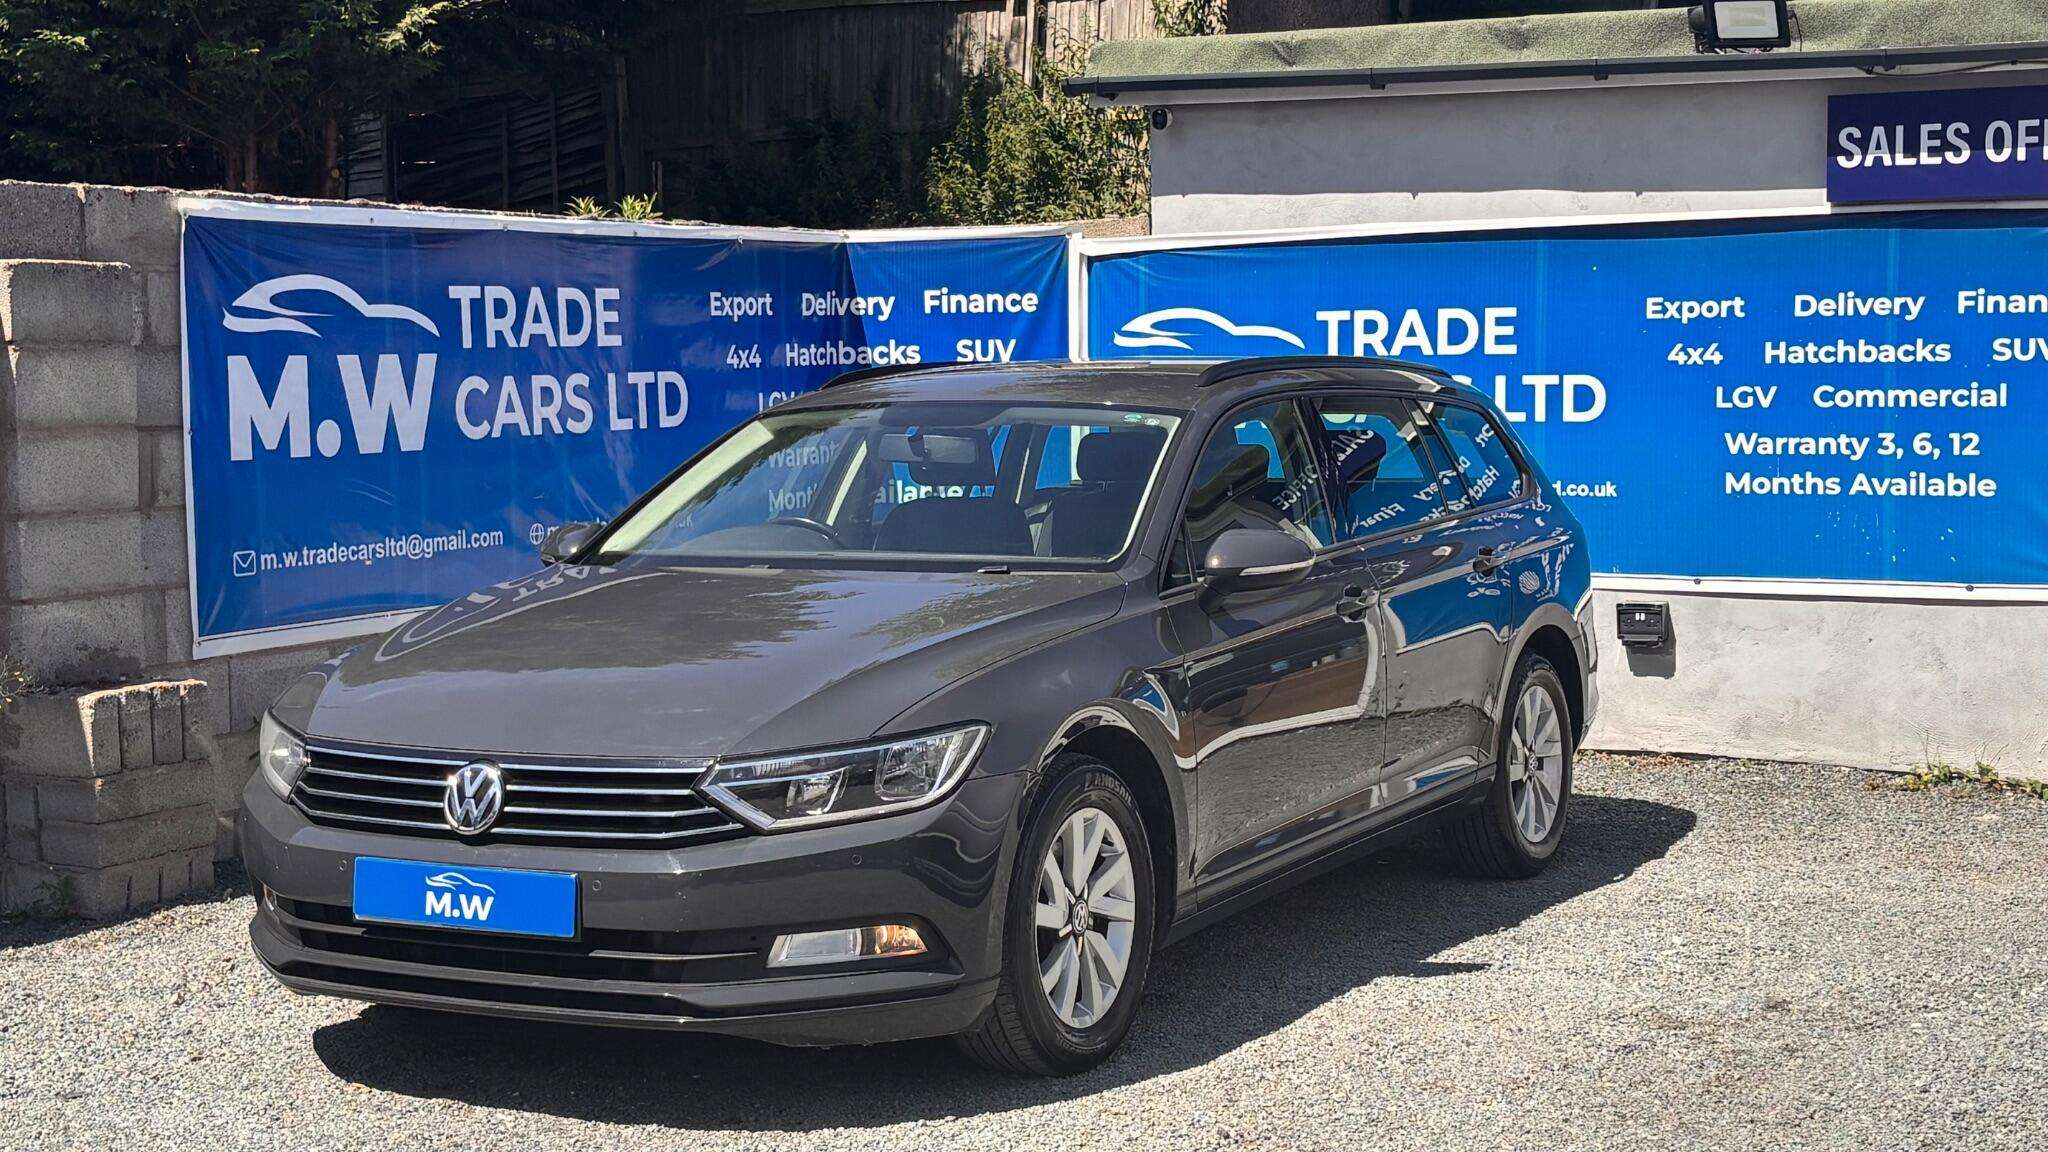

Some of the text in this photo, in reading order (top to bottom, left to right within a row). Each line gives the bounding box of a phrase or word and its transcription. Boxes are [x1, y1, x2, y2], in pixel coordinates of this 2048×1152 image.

[1837, 119, 2048, 168] SALES OF
[449, 285, 622, 349] TRADE
[709, 287, 1039, 322] Export Delivery Finance
[1646, 287, 2048, 323] Export Delivery Finan
[1315, 307, 1518, 357] TRADE
[726, 338, 1017, 369] 4x4 Hatchbacks SUV
[1667, 342, 1724, 365] 4x4
[1764, 339, 1952, 364] Hatchbacks
[227, 353, 438, 461] M.W
[455, 371, 689, 439] CARS LTD
[1494, 374, 1607, 423] LTD
[1716, 382, 2007, 409] LGV Commercial
[1725, 432, 1980, 460] Warranty 3, 6, 12
[1725, 472, 1997, 497] Months Available
[260, 529, 504, 570] m.w.tradecarsltd@gmail.com
[425, 890, 495, 921] M.W
